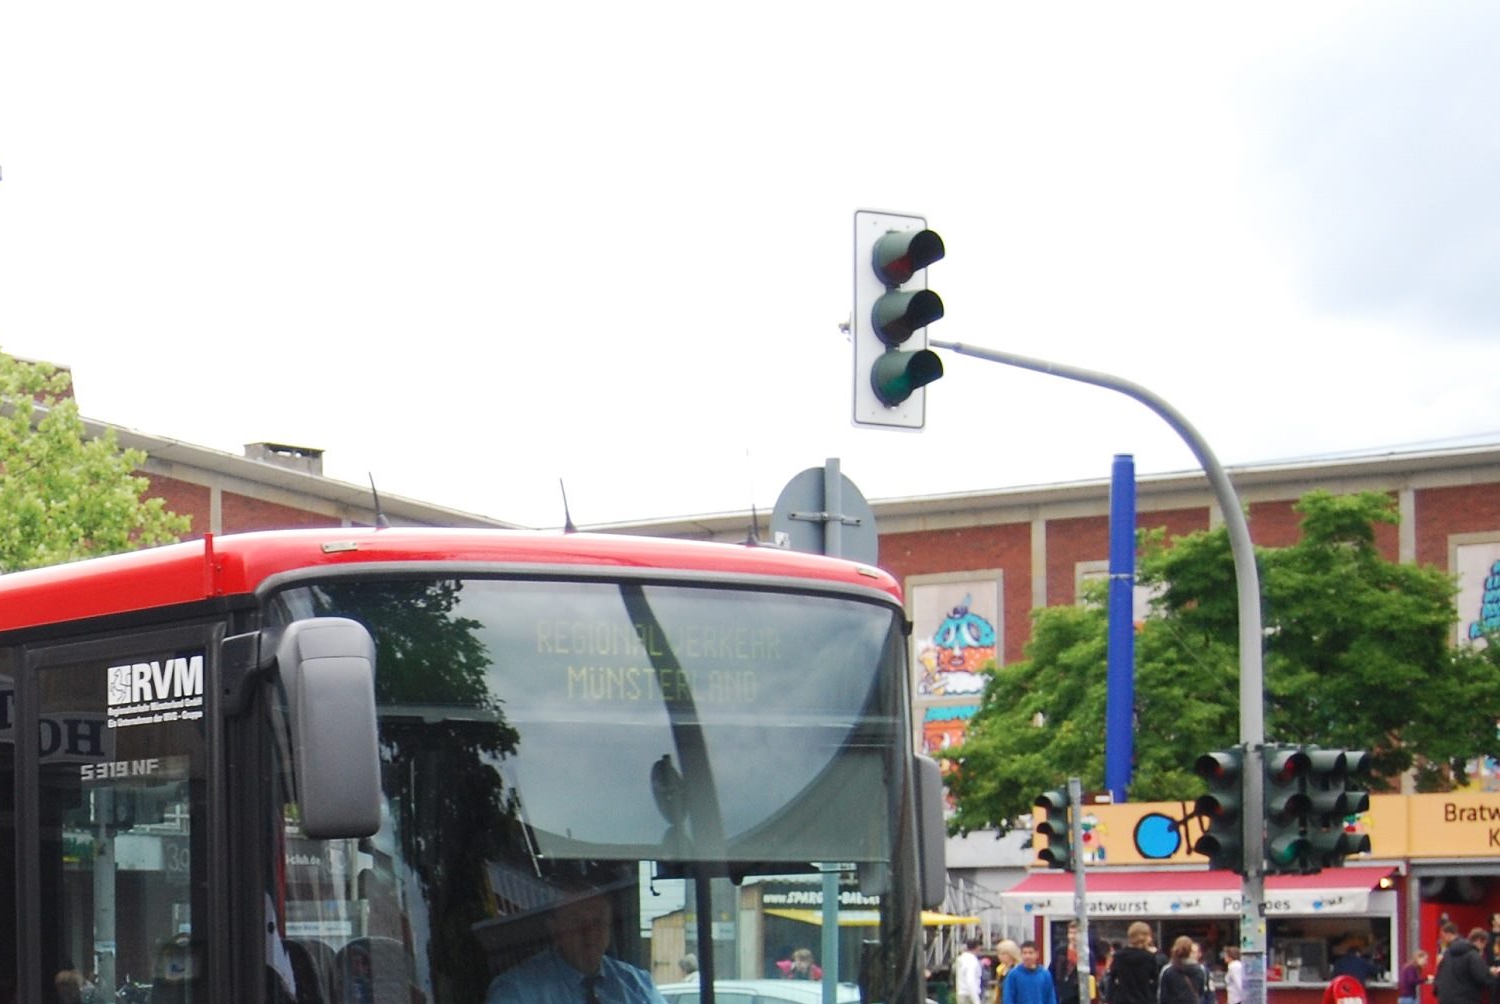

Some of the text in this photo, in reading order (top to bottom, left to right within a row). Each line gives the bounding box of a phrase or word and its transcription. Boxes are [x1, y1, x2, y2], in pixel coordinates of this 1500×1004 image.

[131, 655, 204, 703] RVM
[96, 761, 129, 778] 319
[131, 758, 160, 776] NF
[1074, 897, 1291, 912] atwurst Pooes
